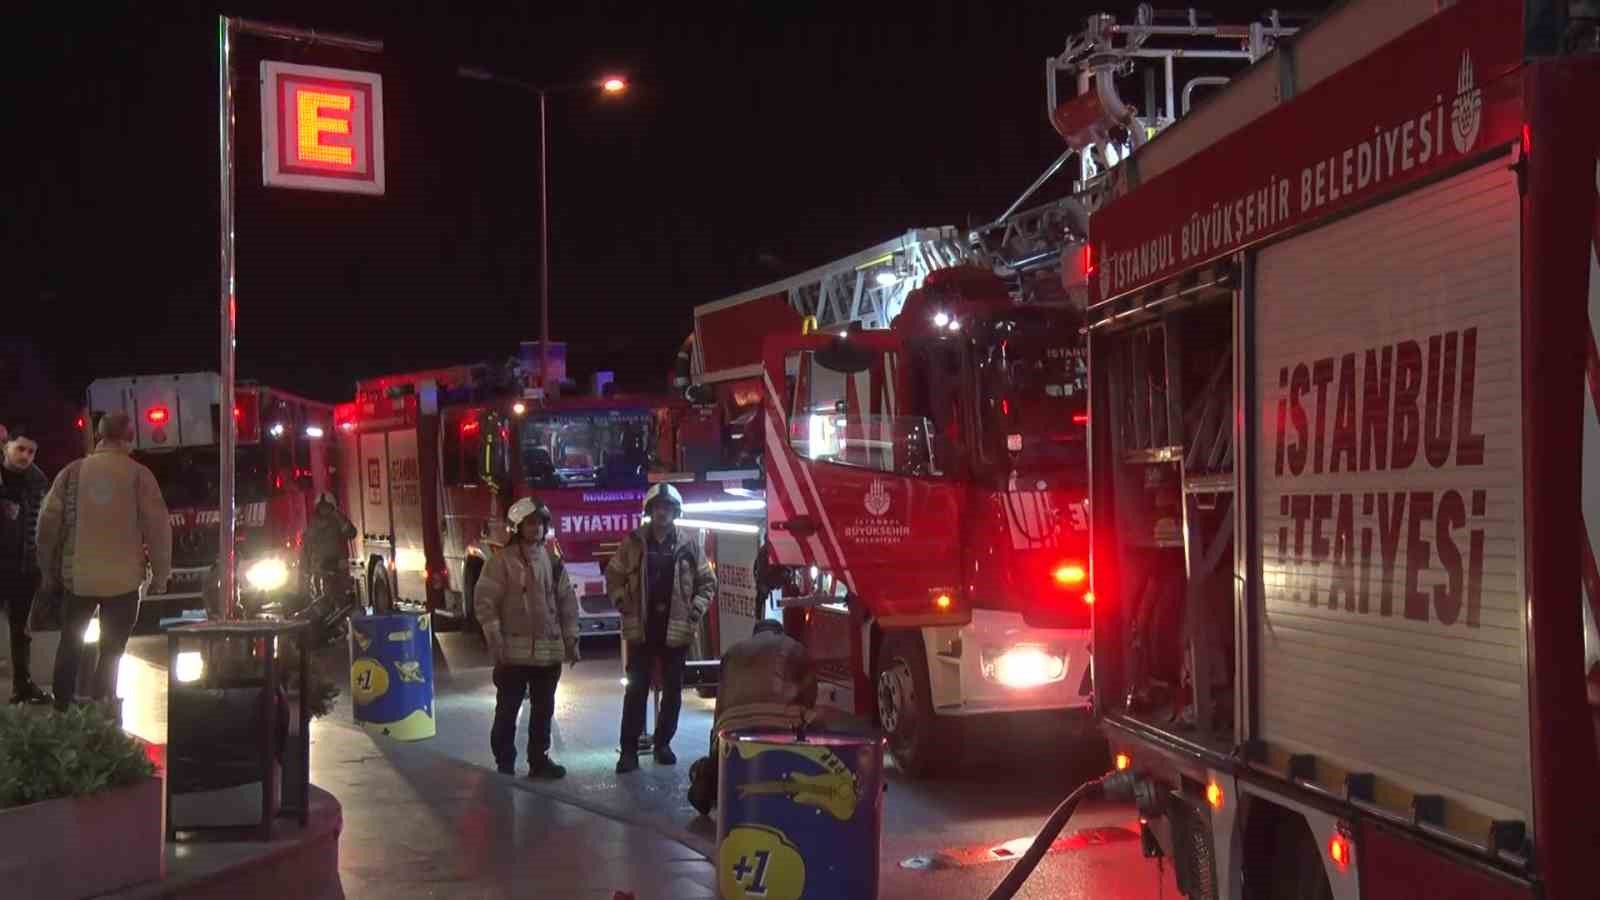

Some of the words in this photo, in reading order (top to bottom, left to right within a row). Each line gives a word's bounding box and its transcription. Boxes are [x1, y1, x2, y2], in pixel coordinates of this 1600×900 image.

[297, 90, 353, 165] E
[1114, 233, 1175, 289] İSTANBUL
[1181, 173, 1290, 260] BÜYÜKŞEHİR
[1300, 94, 1445, 213] BELEDİYESİ
[1274, 327, 1486, 477] İSTANBUL
[1277, 490, 1487, 629] İTFAİYESİ
[733, 850, 773, 896] +1
